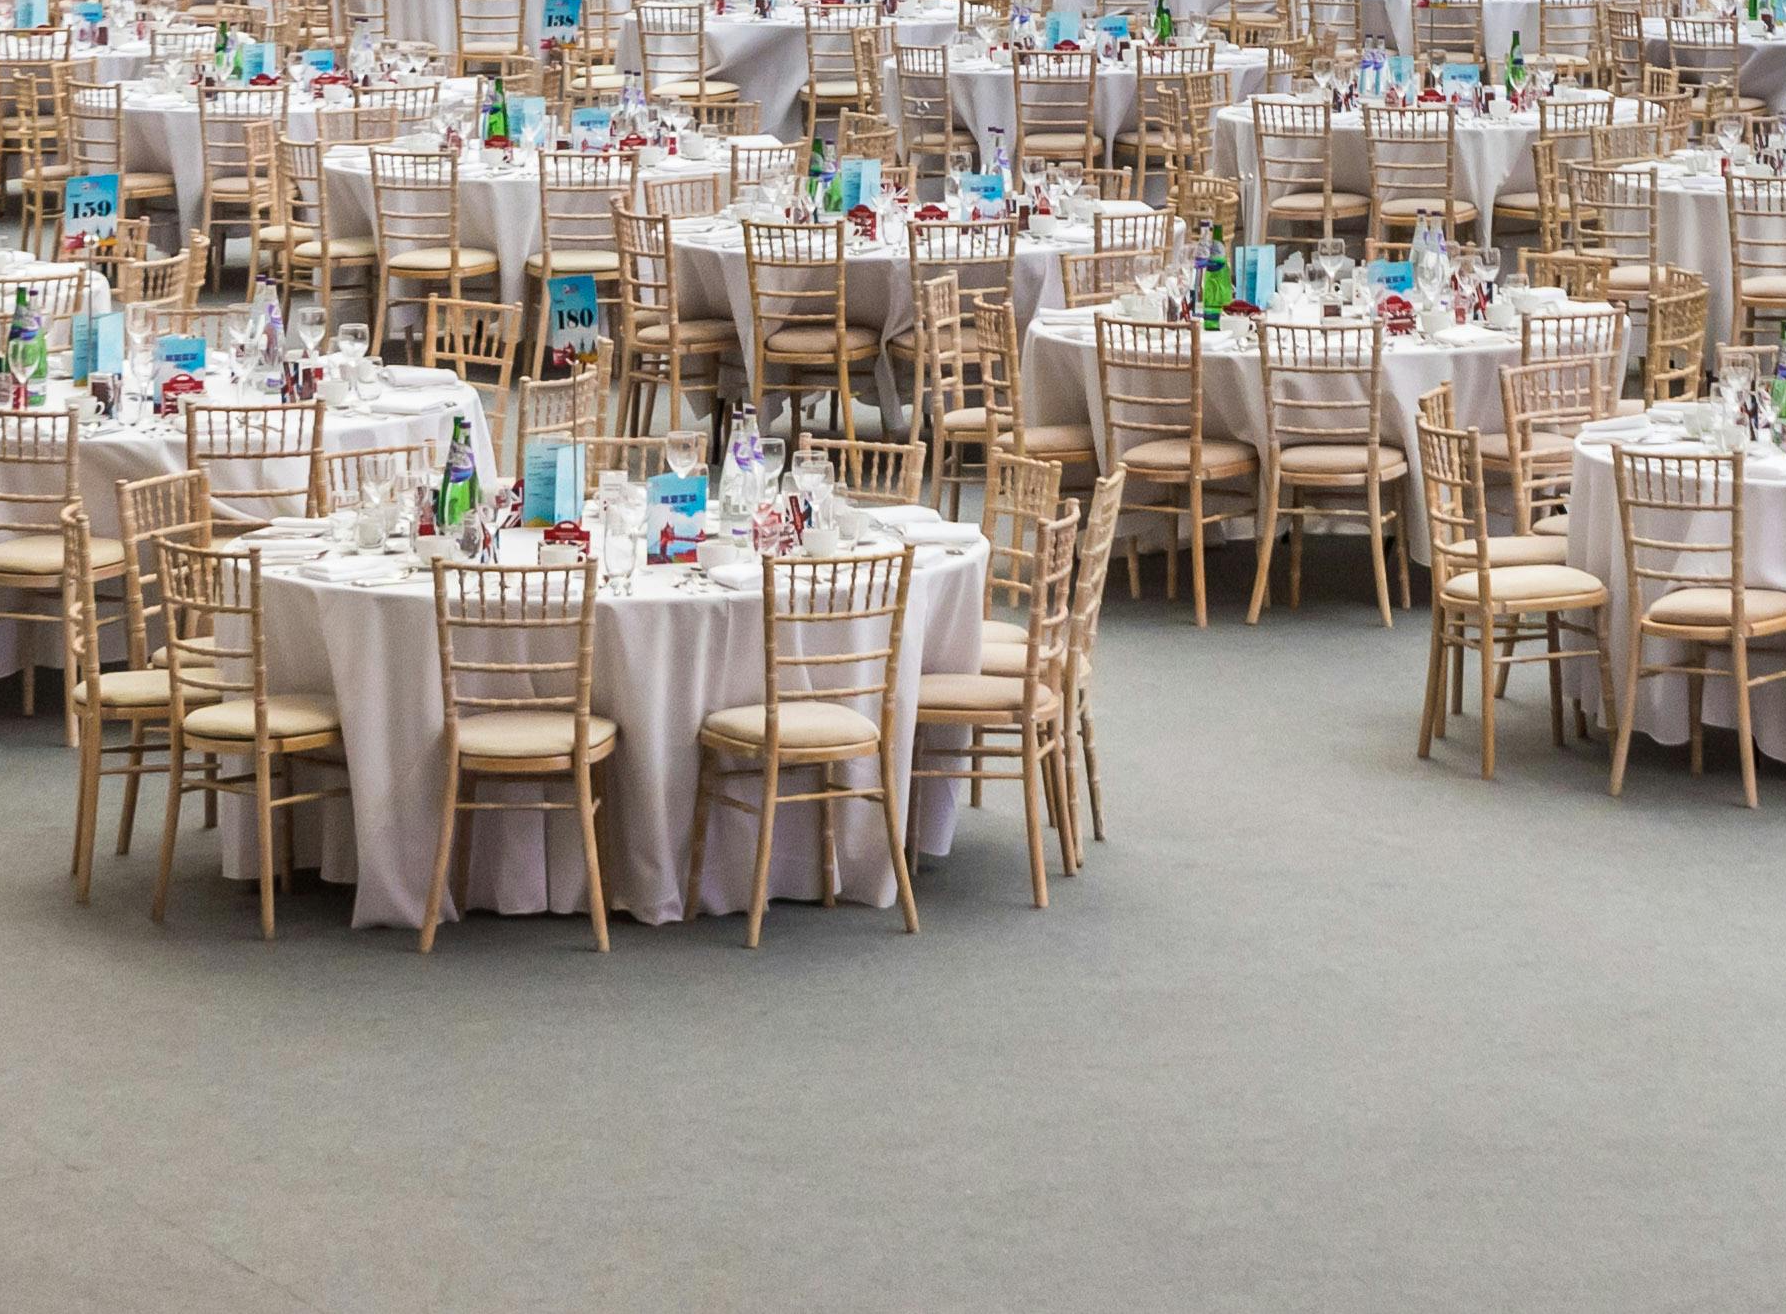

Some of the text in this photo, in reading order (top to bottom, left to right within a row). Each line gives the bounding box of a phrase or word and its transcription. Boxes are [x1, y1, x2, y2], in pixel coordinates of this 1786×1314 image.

[547, 14, 574, 27] 138
[72, 200, 112, 219] 159
[557, 307, 594, 330] 180
